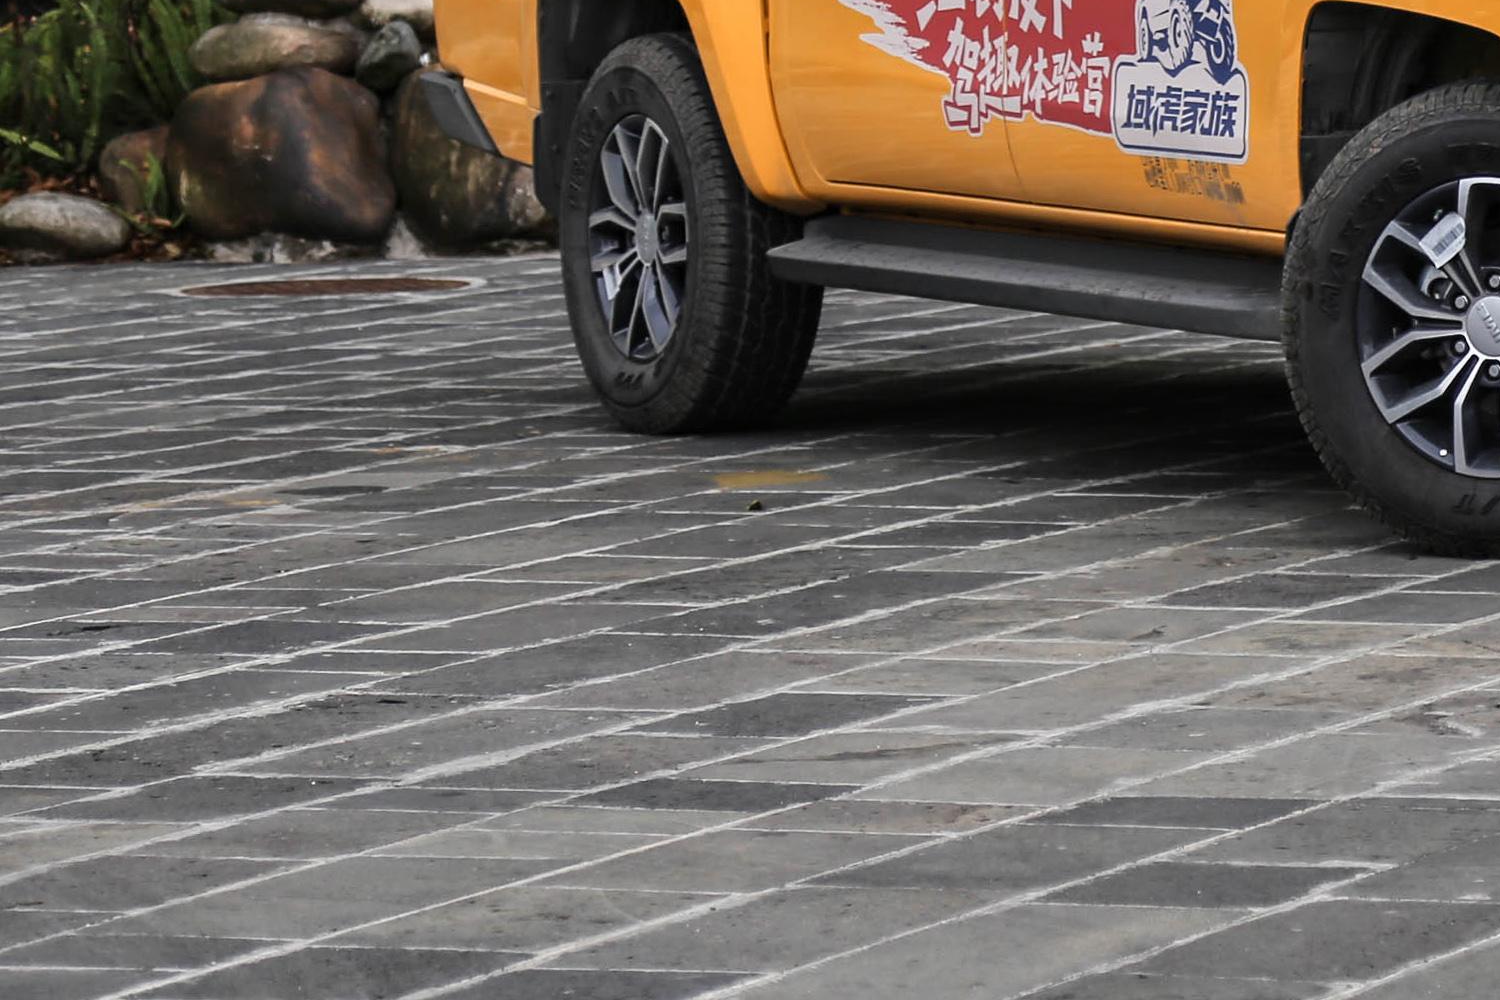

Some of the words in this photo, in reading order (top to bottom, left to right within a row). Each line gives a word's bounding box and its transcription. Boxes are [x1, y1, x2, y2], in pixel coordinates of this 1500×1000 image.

[942, 17, 1111, 127] 驾趣体验营
[1121, 84, 1240, 138] 域虎家族
